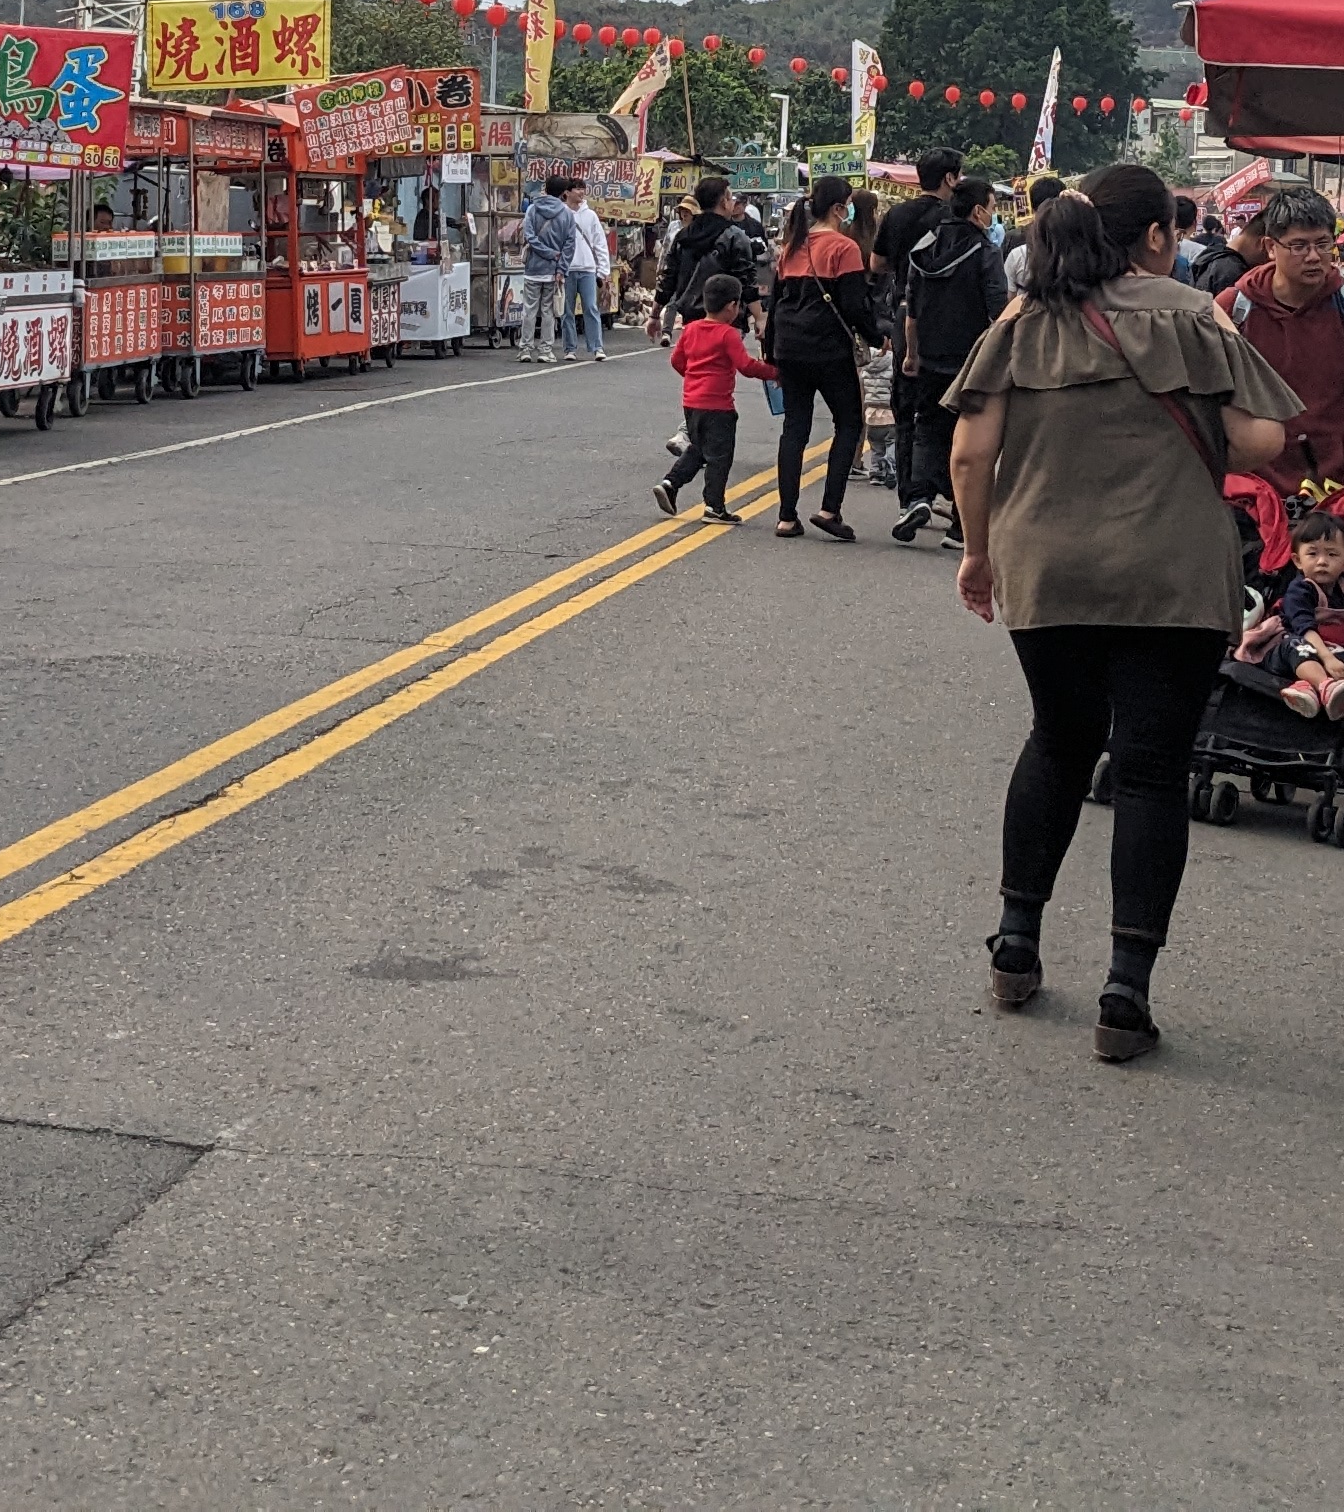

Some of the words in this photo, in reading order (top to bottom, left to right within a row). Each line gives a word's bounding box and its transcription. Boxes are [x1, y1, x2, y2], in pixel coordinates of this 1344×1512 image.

[155, 13, 322, 82] 燒酒螺
[85, 153, 102, 166] 30
[104, 156, 120, 168] 50
[526, 158, 635, 185] 飛魚卵香腸
[307, 287, 362, 328] 烤一夏
